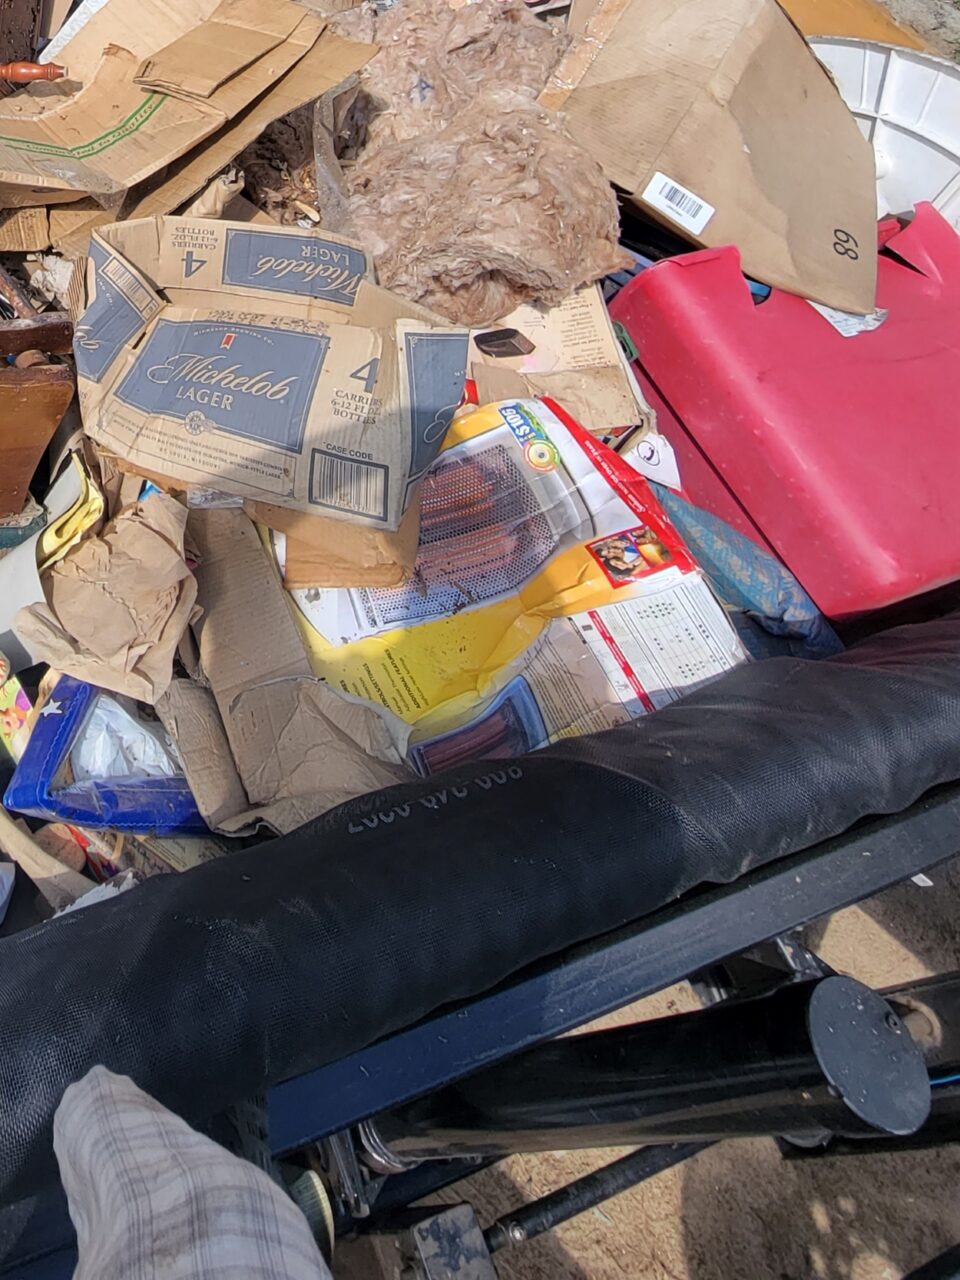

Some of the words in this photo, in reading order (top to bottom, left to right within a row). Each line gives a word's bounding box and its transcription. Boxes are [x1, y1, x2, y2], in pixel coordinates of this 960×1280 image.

[171, 240, 217, 249] CARRIERS
[174, 227, 215, 236] BOTTLES
[181, 251, 206, 278] 4
[301, 245, 349, 266] LAGER
[147, 352, 290, 405] Michelob
[349, 357, 379, 394] 4
[176, 386, 234, 411] LAGER
[325, 443, 347, 455] CASE
[348, 450, 373, 460] CODE
[384, 648, 403, 676] FEATURES
[400, 676, 421, 709] ADDITIONAL
